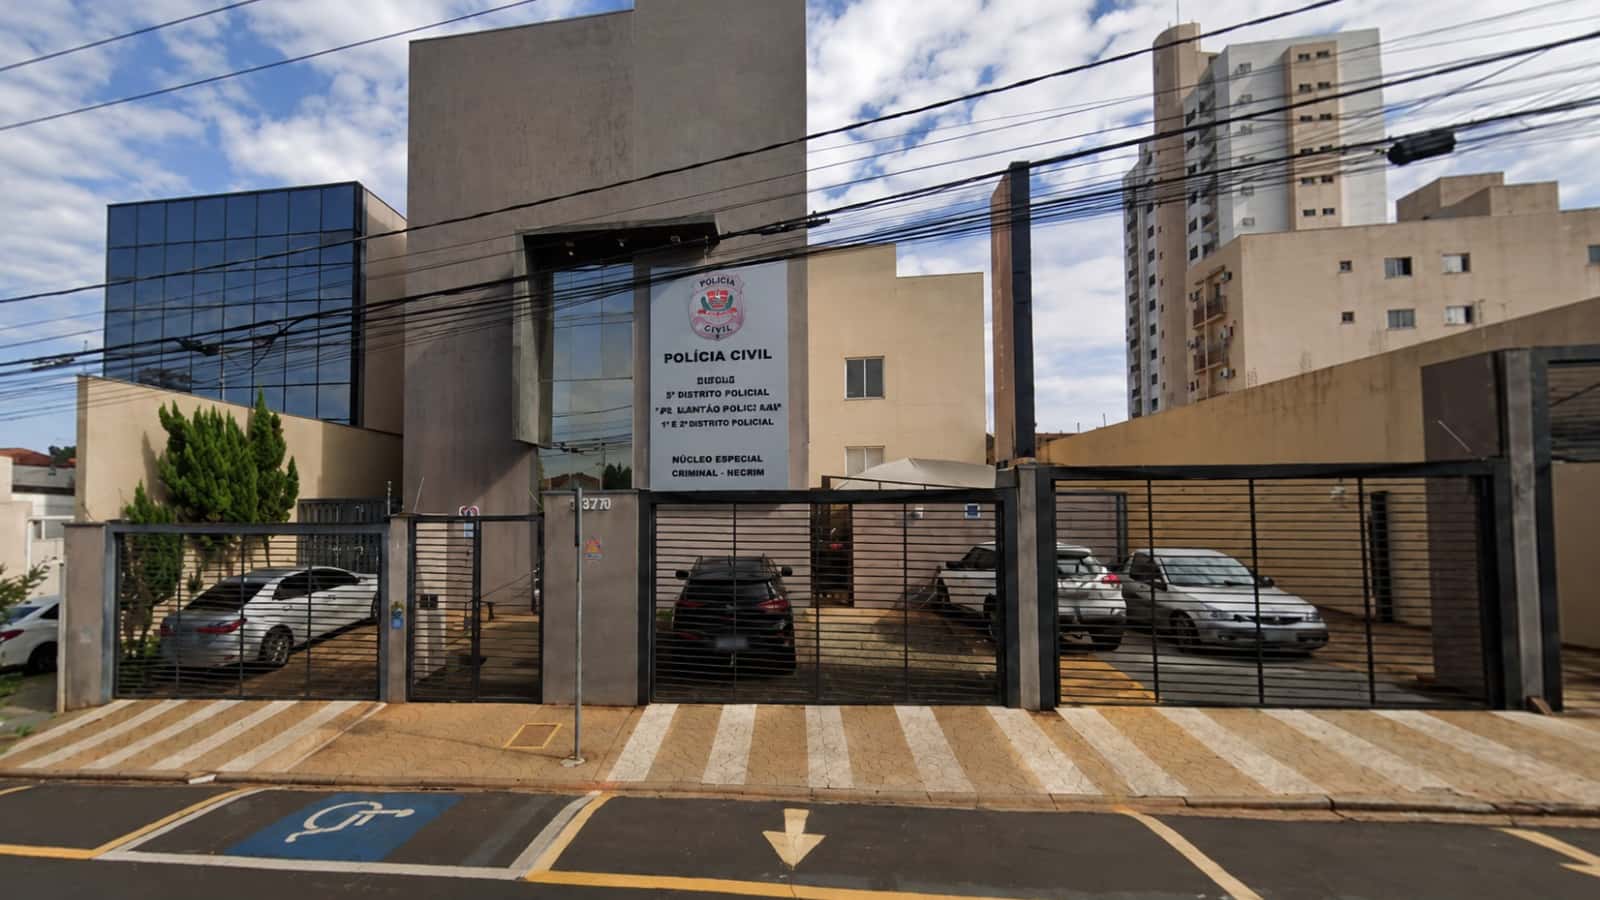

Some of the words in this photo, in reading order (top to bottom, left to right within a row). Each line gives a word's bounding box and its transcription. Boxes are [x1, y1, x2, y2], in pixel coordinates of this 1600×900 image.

[704, 325, 732, 333] CIVIL
[664, 349, 726, 363] POLÍCIA
[730, 349, 772, 360] CIVIL
[678, 390, 722, 399] DISTRITO
[725, 388, 770, 397] POLICIAL
[689, 419, 729, 427] DISTRITO
[732, 418, 774, 427] POLICIAL
[672, 454, 712, 464] NÚCLEO
[715, 455, 763, 463] ESPECIAL
[582, 497, 611, 510] 3770
